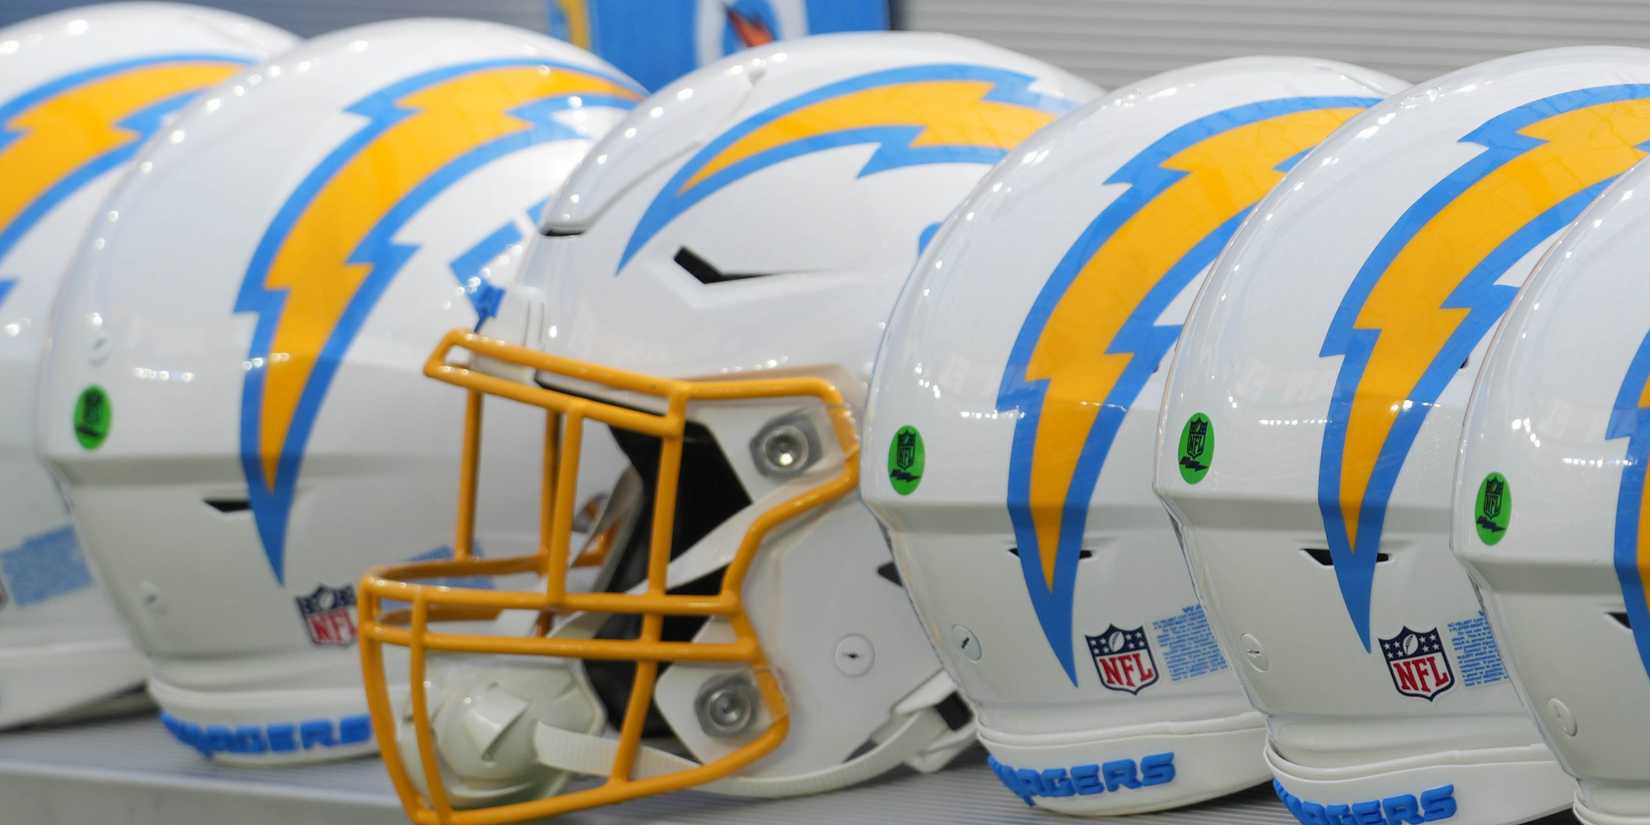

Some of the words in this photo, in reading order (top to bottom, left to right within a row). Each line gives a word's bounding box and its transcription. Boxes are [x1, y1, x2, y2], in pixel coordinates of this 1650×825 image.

[1099, 652, 1154, 687] NFL
[1392, 656, 1450, 693] NFL
[987, 752, 1176, 807] RGERS
